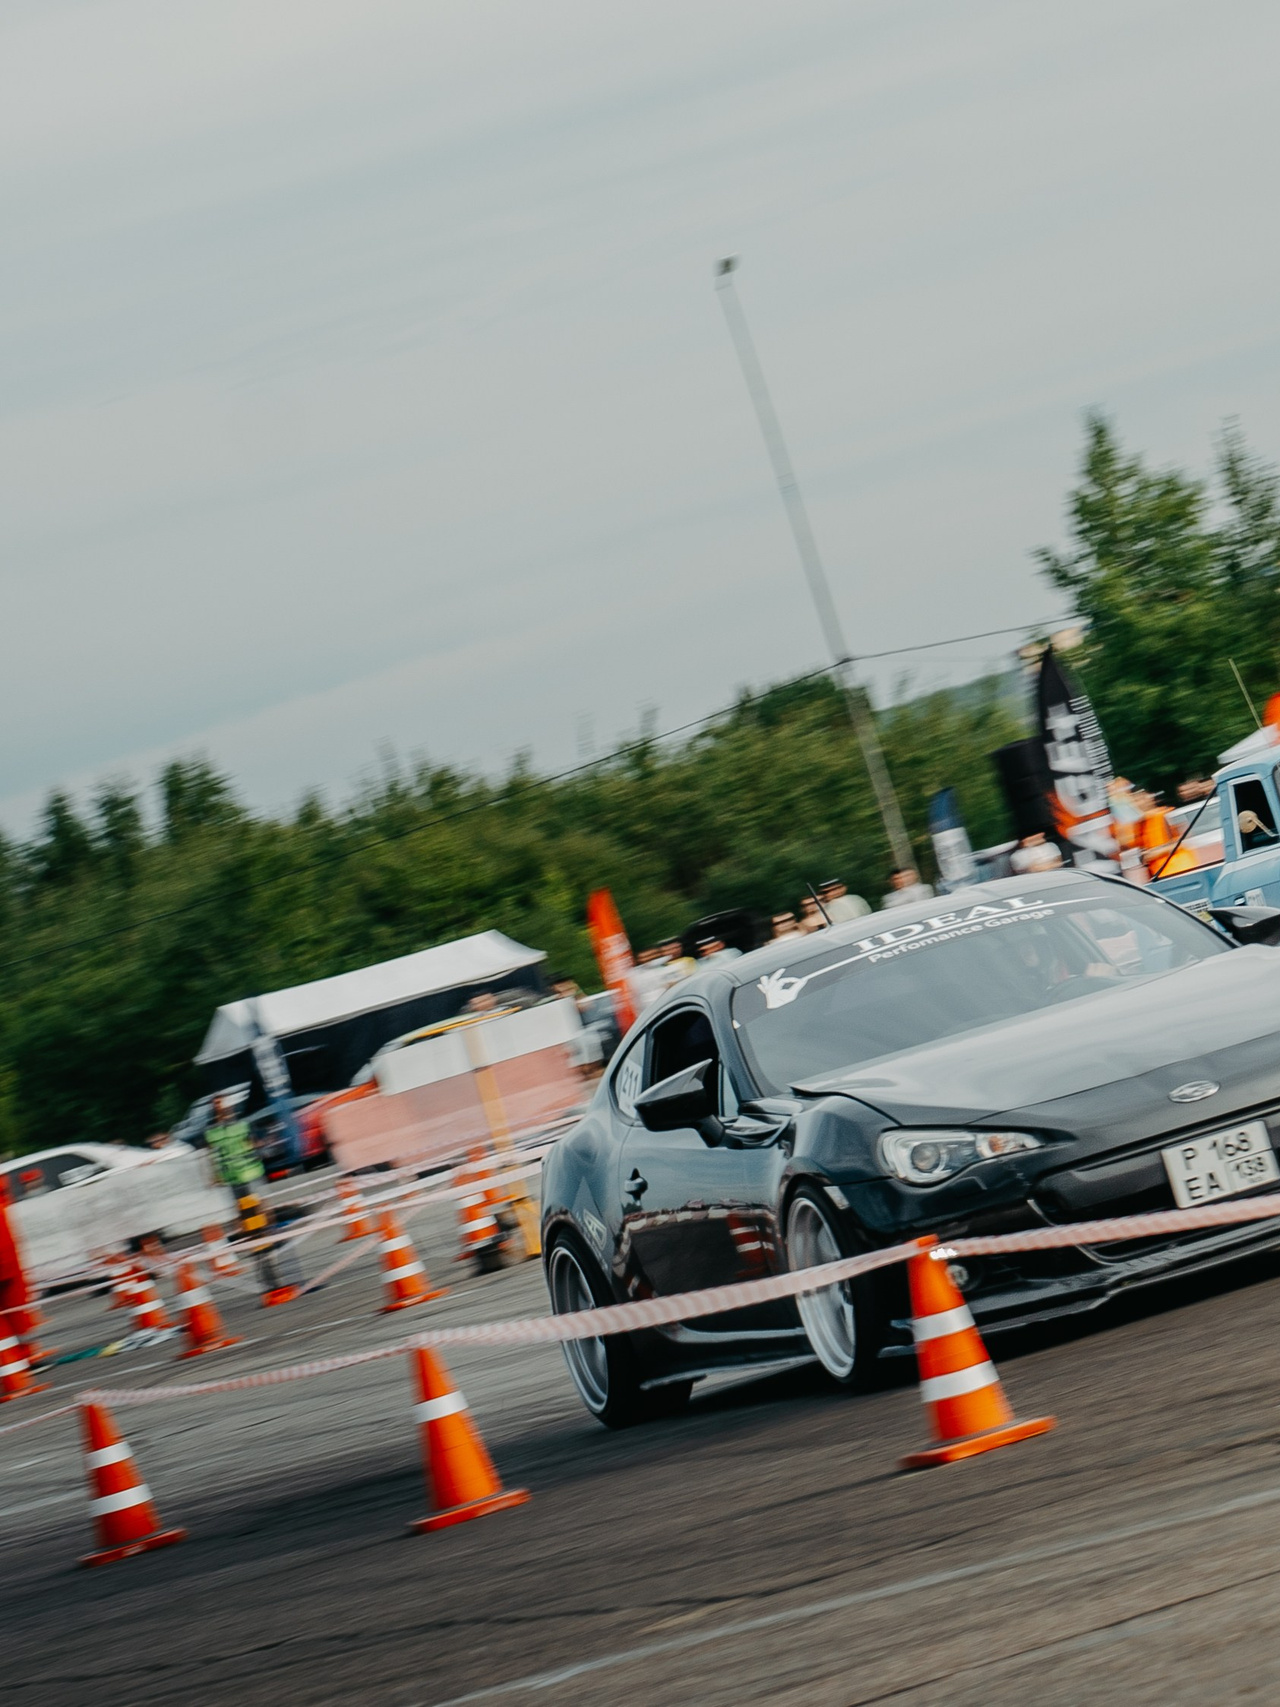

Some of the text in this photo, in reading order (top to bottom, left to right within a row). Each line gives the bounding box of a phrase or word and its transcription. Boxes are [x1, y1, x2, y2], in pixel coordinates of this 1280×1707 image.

[852, 897, 1044, 953] IDEAL
[984, 908, 1055, 928] Garage
[1181, 1131, 1252, 1170] P 168
[1184, 1172, 1225, 1200] EA
